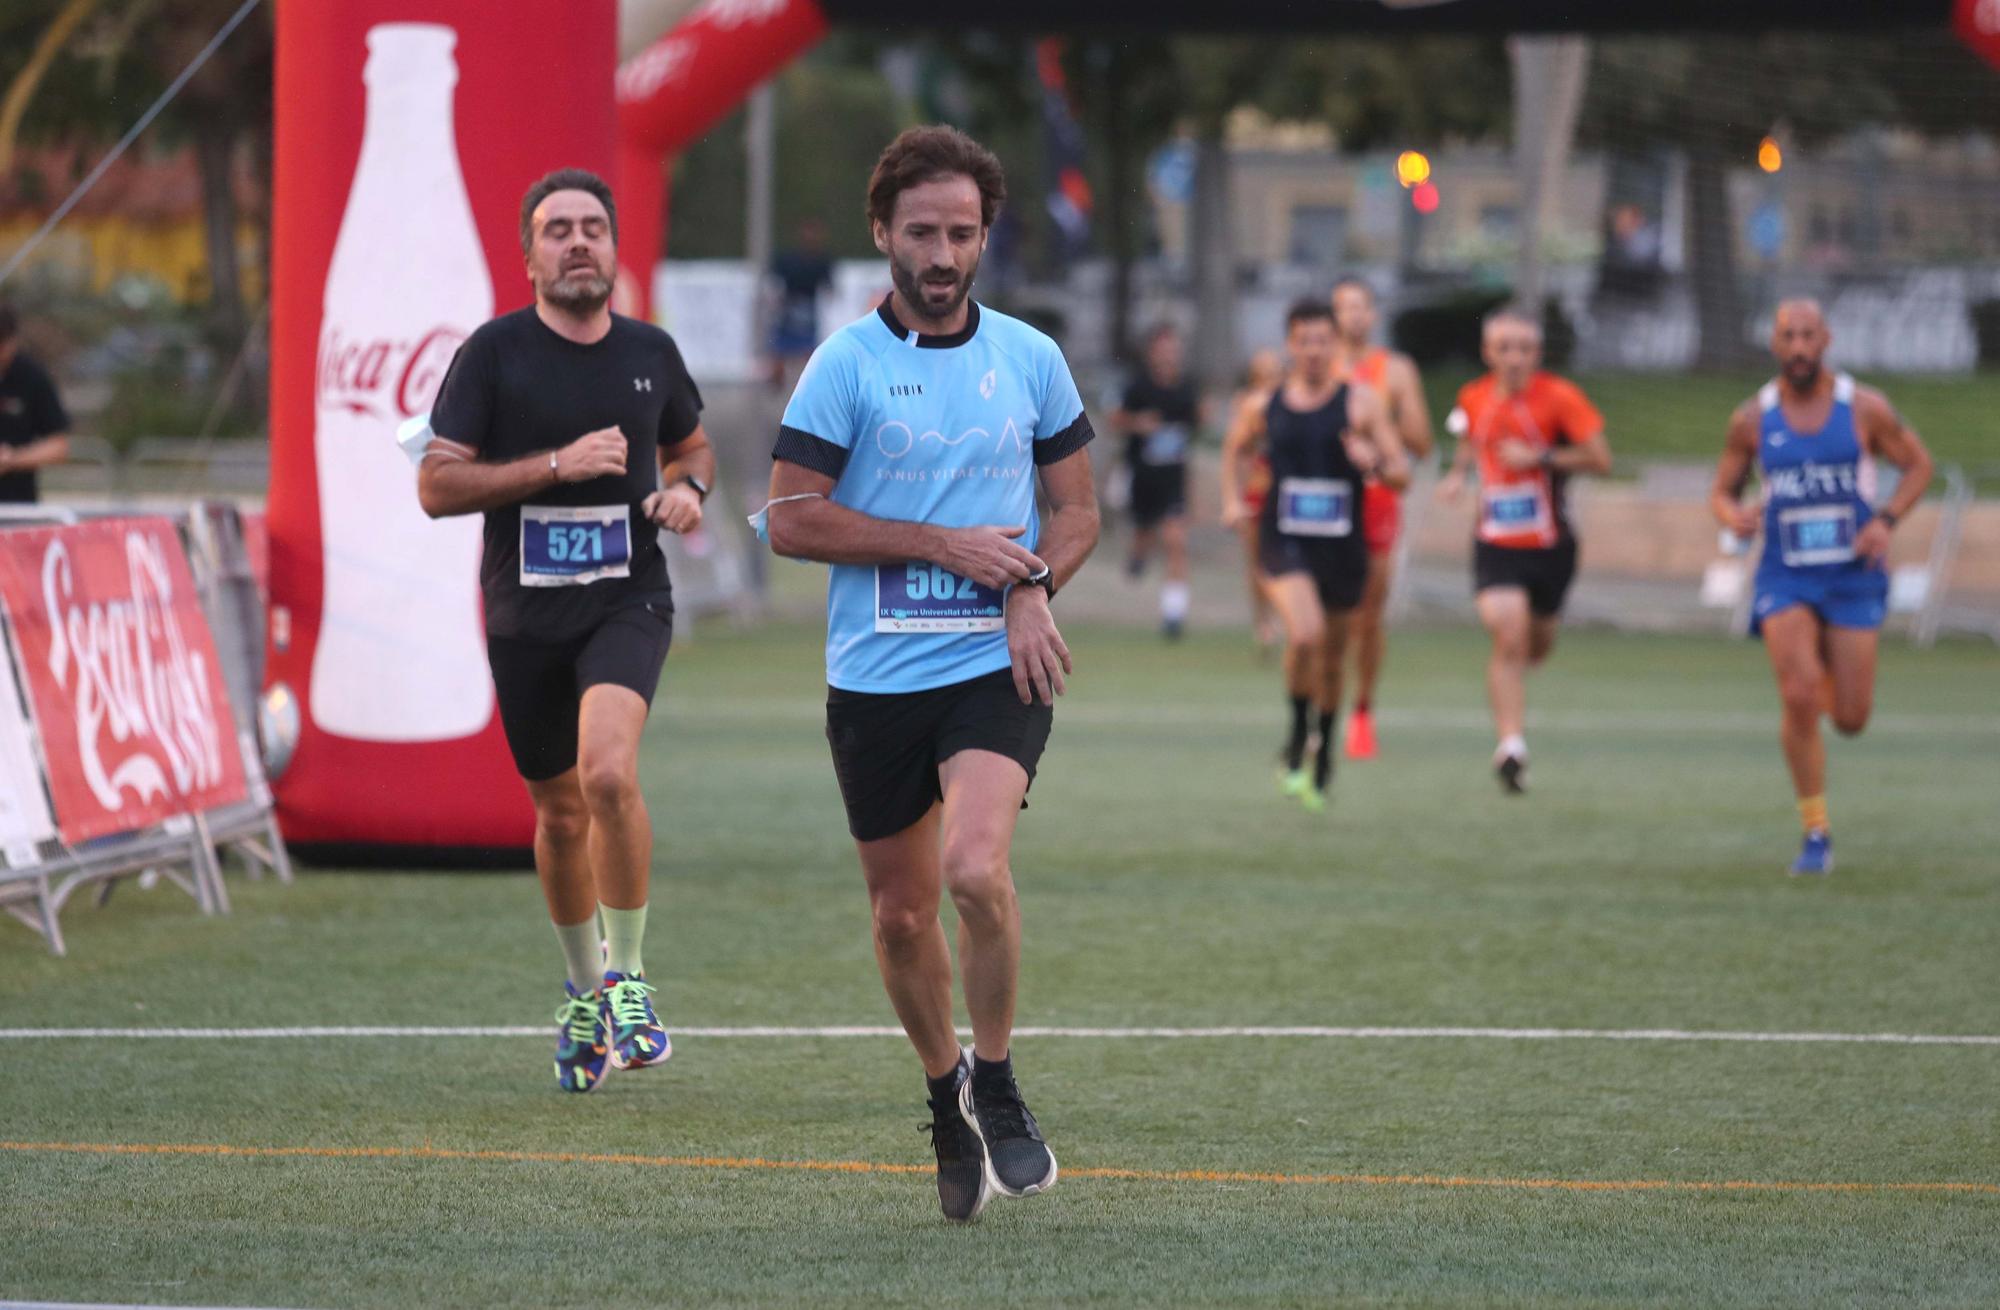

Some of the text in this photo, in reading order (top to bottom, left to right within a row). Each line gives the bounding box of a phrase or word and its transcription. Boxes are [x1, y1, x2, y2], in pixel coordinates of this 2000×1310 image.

[876, 467, 926, 481] SANUS
[932, 466, 977, 479] VITAE
[548, 527, 603, 562] 521
[906, 562, 978, 600] 562
[880, 608, 889, 616] IX
[920, 608, 960, 616] Universitat
[962, 608, 972, 616] de
